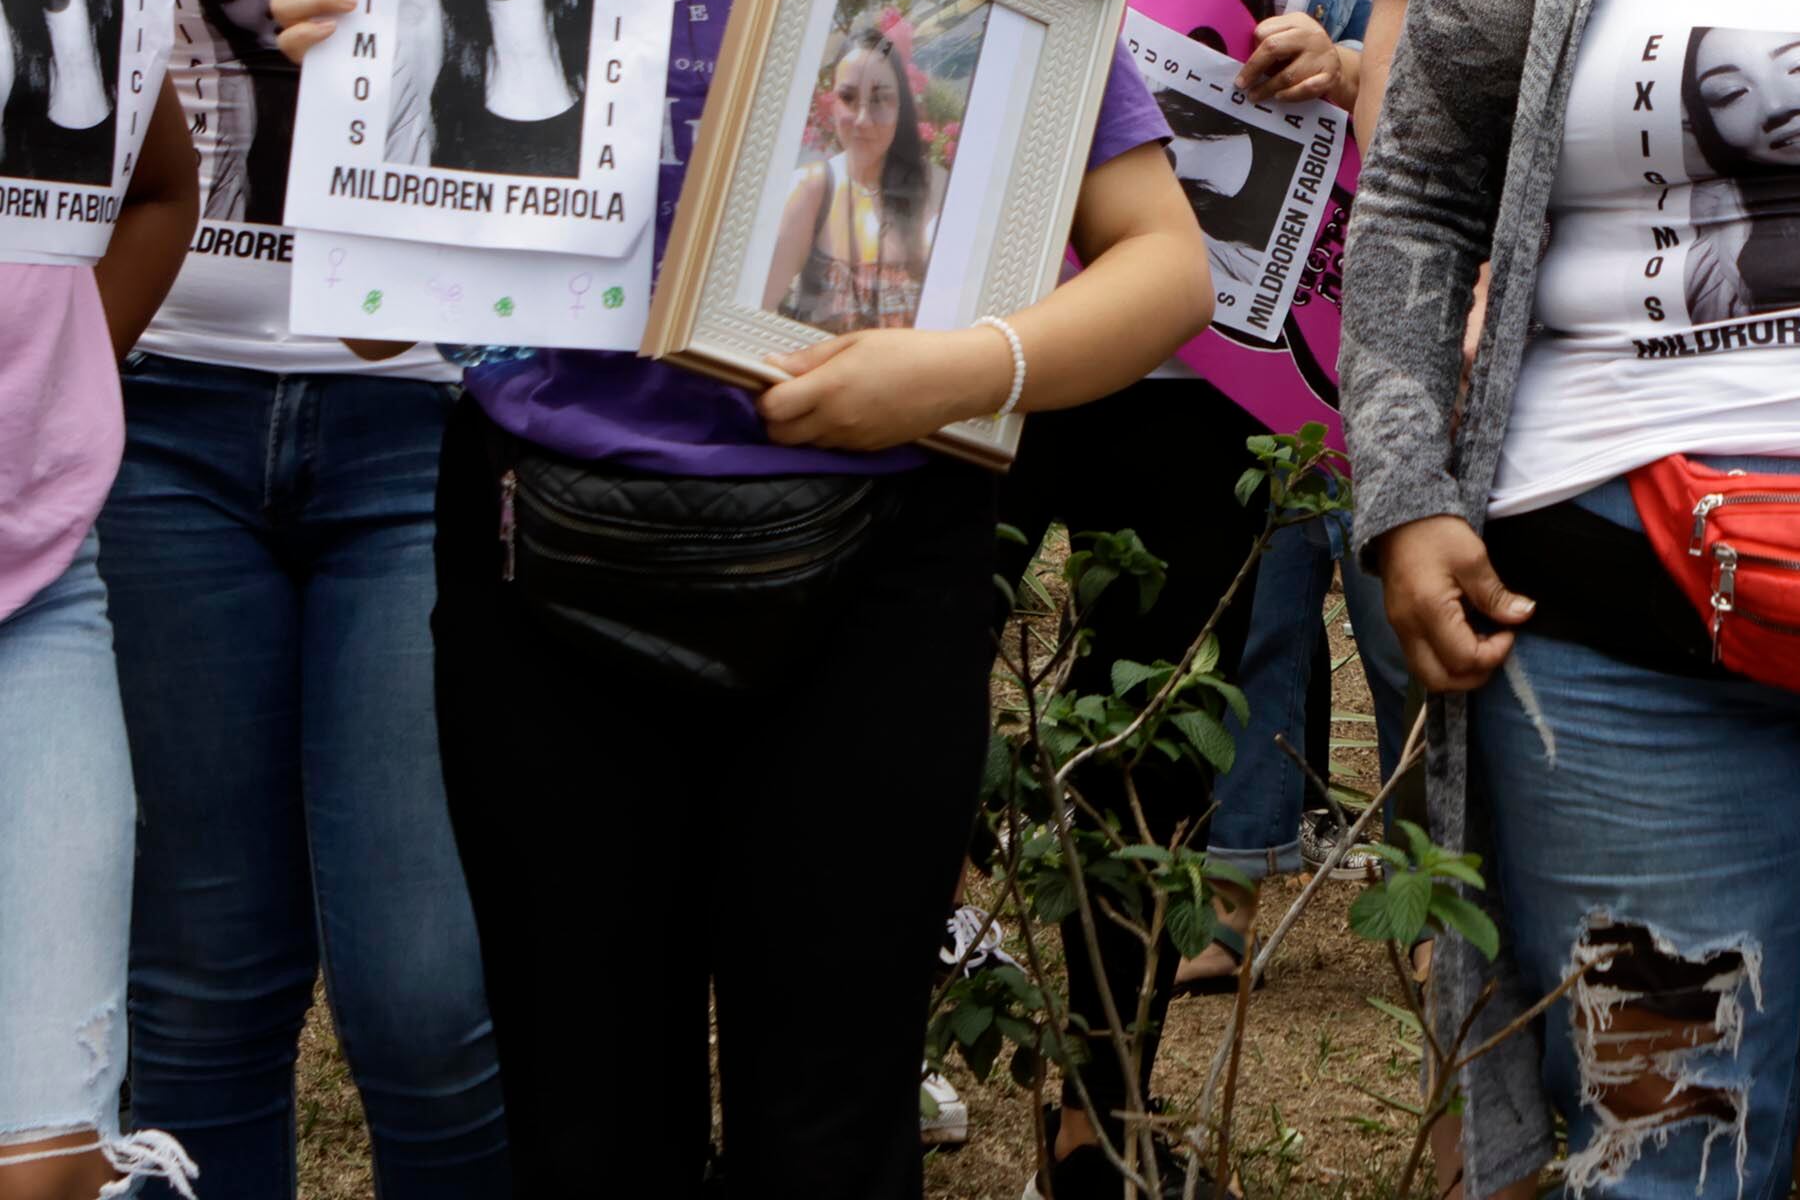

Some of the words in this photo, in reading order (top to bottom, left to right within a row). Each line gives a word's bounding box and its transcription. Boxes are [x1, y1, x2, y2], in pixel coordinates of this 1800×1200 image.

[1128, 38, 1305, 130] JUSTICIA
[330, 165, 495, 214] MILDROREN
[505, 184, 626, 223] FABIOLA
[1246, 208, 1310, 331] MILDROREN
[1298, 116, 1338, 206] FABIOLA
